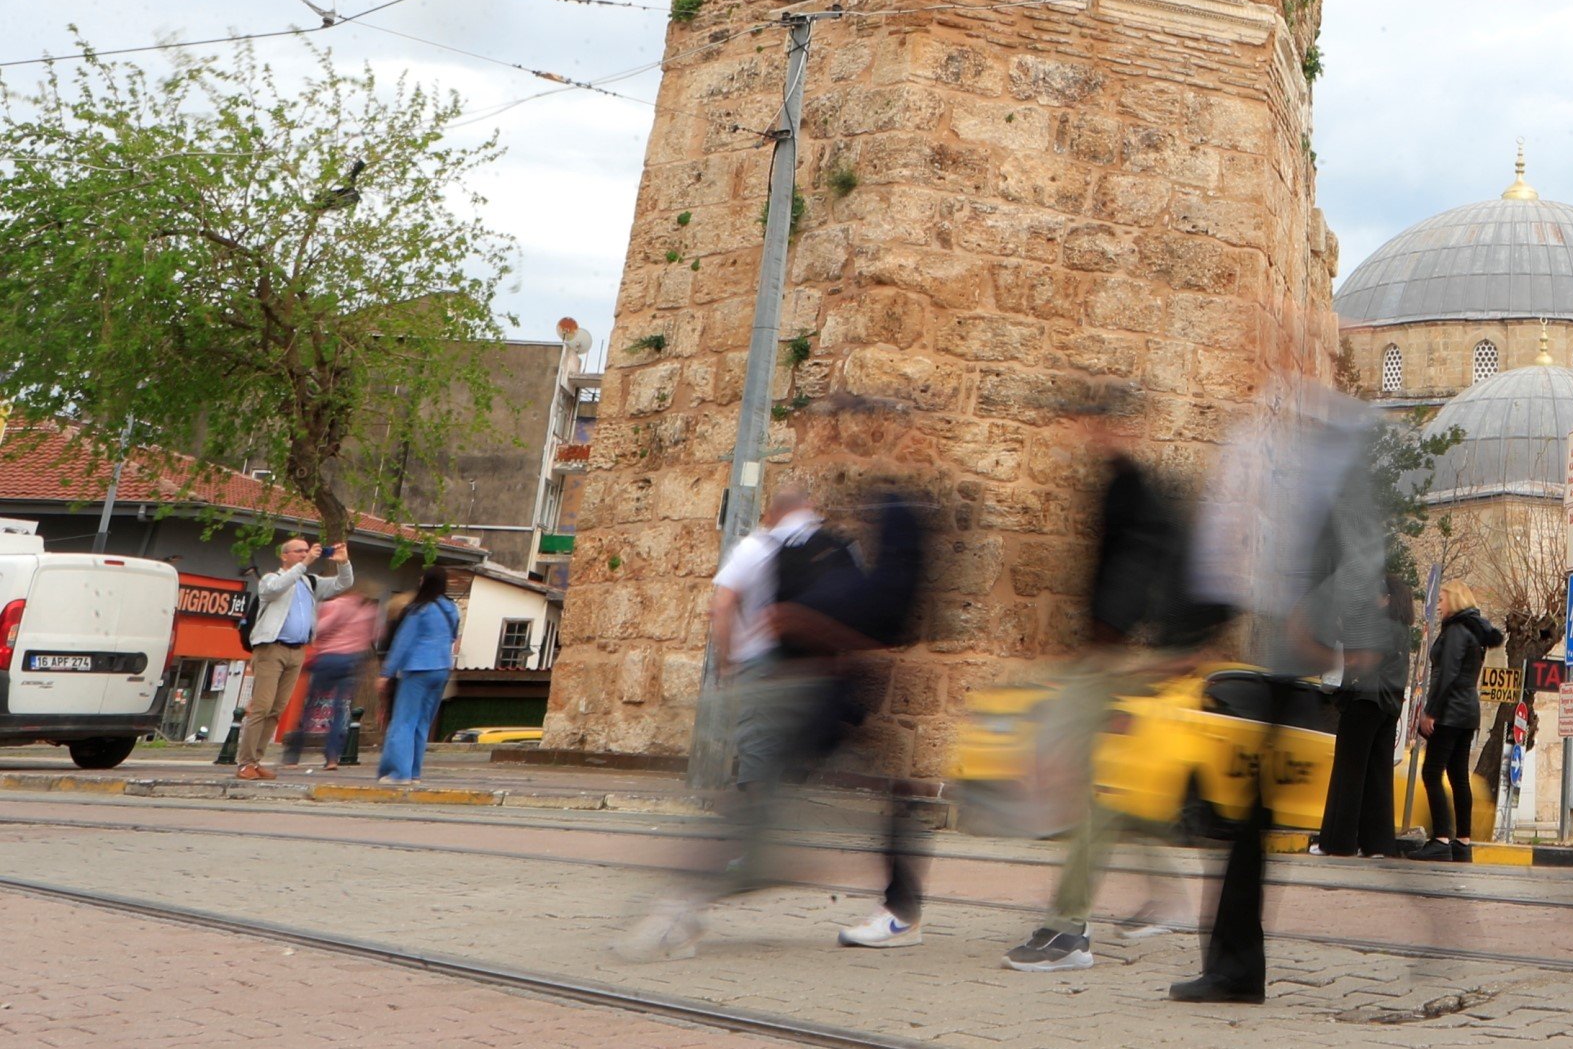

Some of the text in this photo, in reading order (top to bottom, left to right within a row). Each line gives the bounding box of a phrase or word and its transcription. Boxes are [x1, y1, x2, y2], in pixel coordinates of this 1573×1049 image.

[37, 656, 90, 668] 16 APF 274
